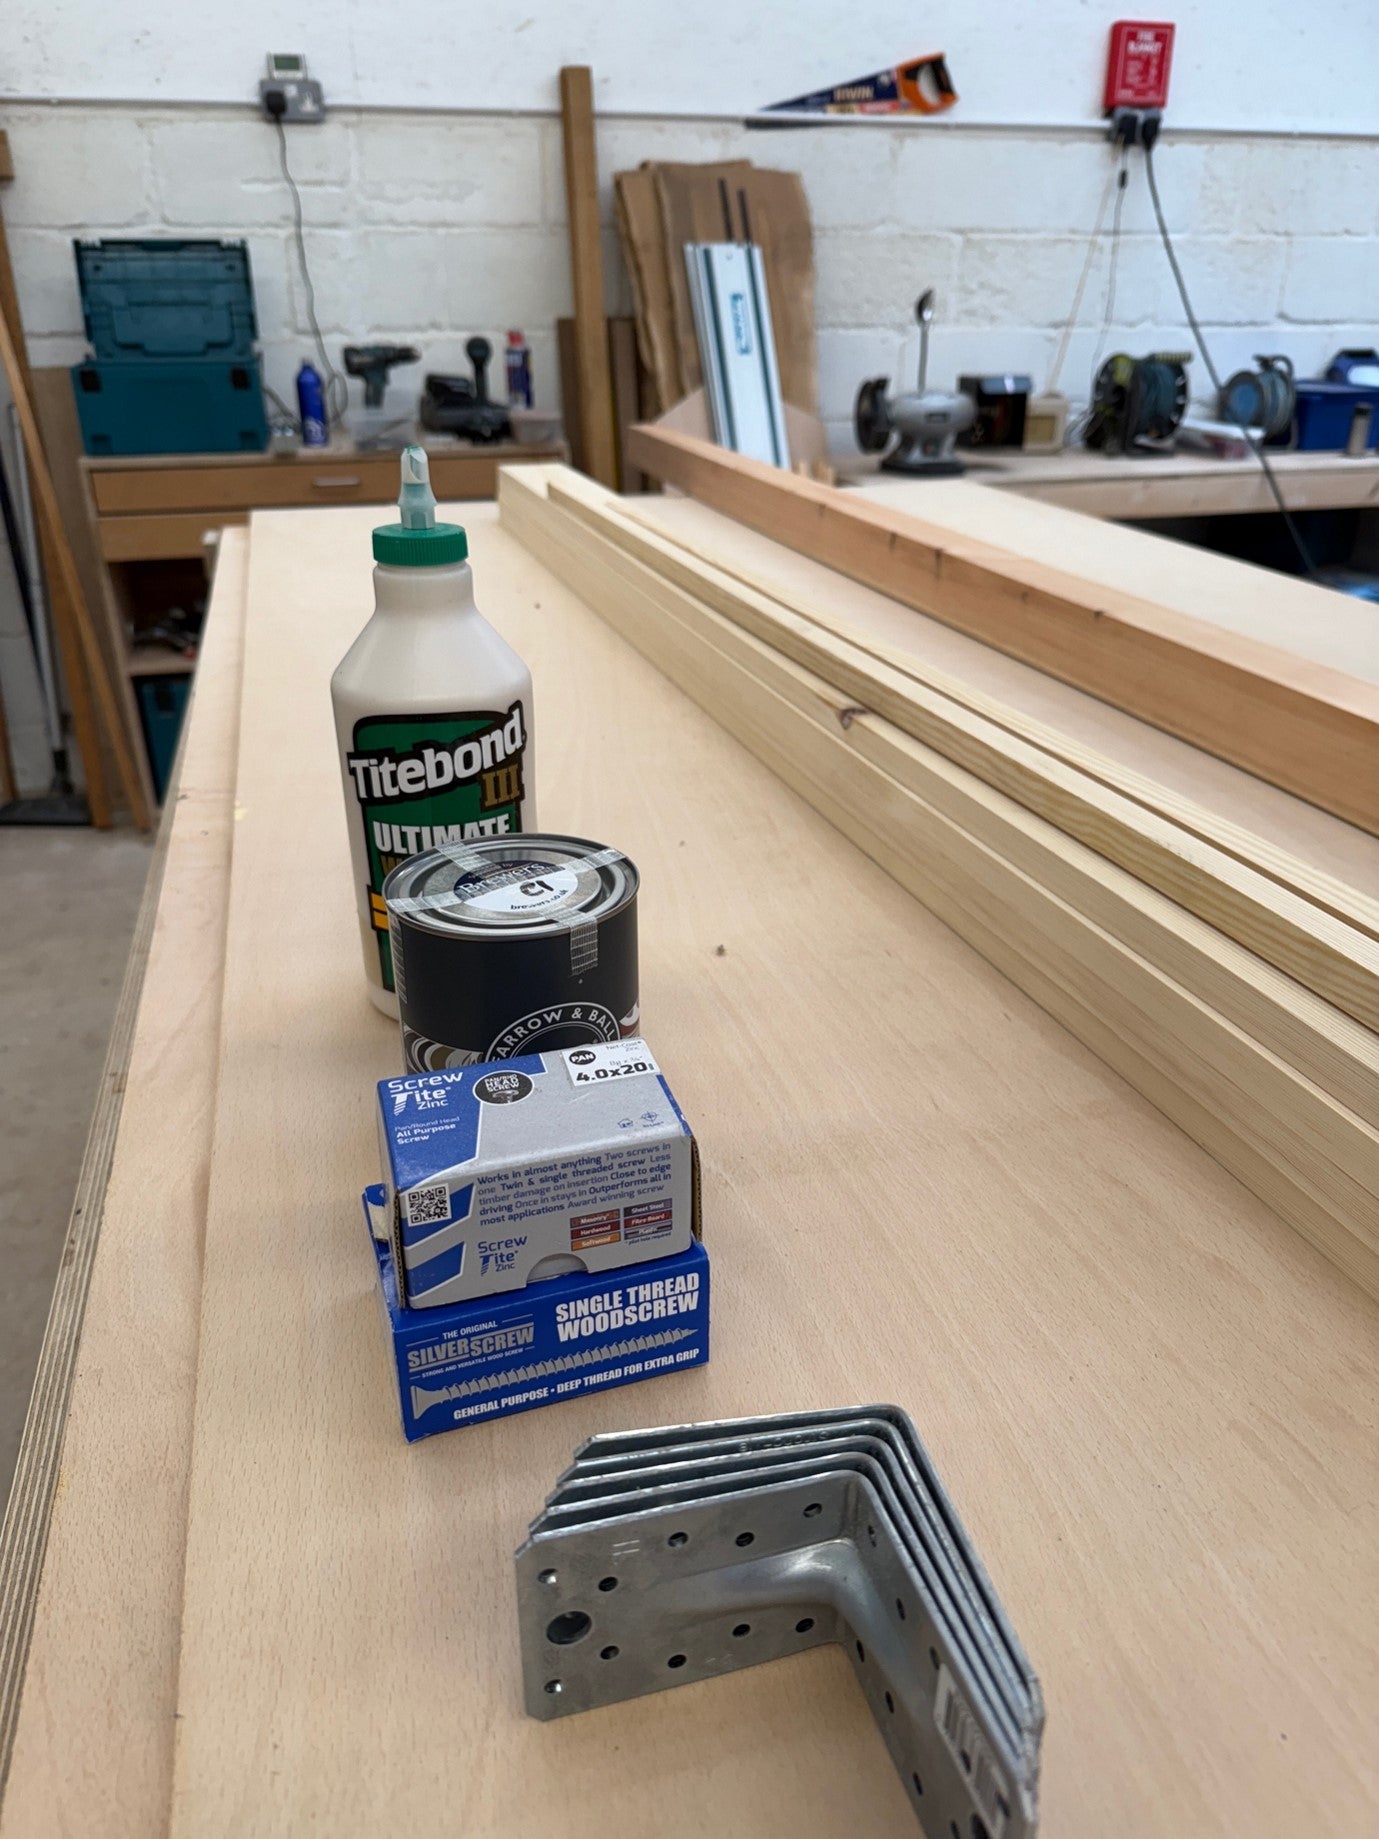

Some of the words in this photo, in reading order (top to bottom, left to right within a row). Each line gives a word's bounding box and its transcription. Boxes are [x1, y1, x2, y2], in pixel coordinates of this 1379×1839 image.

[350, 708, 523, 799] Titebond
[482, 764, 520, 807] III
[457, 863, 545, 894] Brewers
[571, 1007, 583, 1019] &
[588, 1009, 616, 1041] BALL
[571, 1053, 594, 1062] PAN
[576, 1061, 648, 1081] 4.0x20
[388, 1072, 463, 1093] Screw
[485, 1077, 519, 1087] HEAD
[418, 1099, 449, 1110] Zinc
[397, 1130, 411, 1138] All
[414, 1123, 456, 1134] Purpose
[397, 1135, 430, 1145] Screw
[477, 1173, 509, 1185] Works
[512, 1170, 521, 1178] in
[524, 1164, 558, 1176] almost
[561, 1156, 602, 1169] anything
[605, 1152, 624, 1160] Two
[626, 1145, 660, 1157] screws
[662, 1142, 671, 1150] in
[477, 1187, 496, 1195] one
[500, 1181, 523, 1191] Twin
[527, 1178, 535, 1186] &
[539, 1172, 568, 1183] single
[572, 1163, 614, 1177] threaded
[618, 1159, 646, 1169] screw
[650, 1154, 671, 1162] Less
[479, 1194, 511, 1206] timber
[513, 1186, 551, 1198] damage
[567, 1175, 608, 1188] insertion
[610, 1170, 635, 1180] Close
[649, 1163, 671, 1173] edge
[480, 1204, 513, 1215] driving
[515, 1198, 539, 1208] Once
[551, 1191, 577, 1201] stays
[589, 1179, 648, 1194] Outperforms
[650, 1174, 661, 1182] all
[480, 1215, 505, 1226] most
[508, 1204, 565, 1221] applications
[567, 1196, 597, 1208] Award
[599, 1189, 635, 1201] winning
[637, 1185, 665, 1195] screw
[478, 1236, 528, 1254] Screw
[495, 1262, 516, 1272] Zinc
[555, 1289, 623, 1322] SINGLE
[626, 1272, 700, 1305] THREAD
[442, 1329, 459, 1340] THE
[460, 1320, 498, 1336] ORIGINAL
[556, 1290, 700, 1343] WOODSCREW
[407, 1326, 535, 1368] SILVERSCREW
[422, 1368, 445, 1378] STRONG
[445, 1364, 458, 1373] AND
[458, 1357, 486, 1369] VERSATILE
[487, 1352, 504, 1361] WOOD
[505, 1347, 524, 1357] SCREW
[453, 1401, 500, 1420] GENERAL
[501, 1387, 550, 1407] PURPOSE
[556, 1379, 582, 1394] DEEP
[583, 1368, 622, 1386] THREAD
[623, 1362, 643, 1377] FOR
[644, 1356, 675, 1371] EXTRA
[675, 1348, 700, 1363] GRIP
